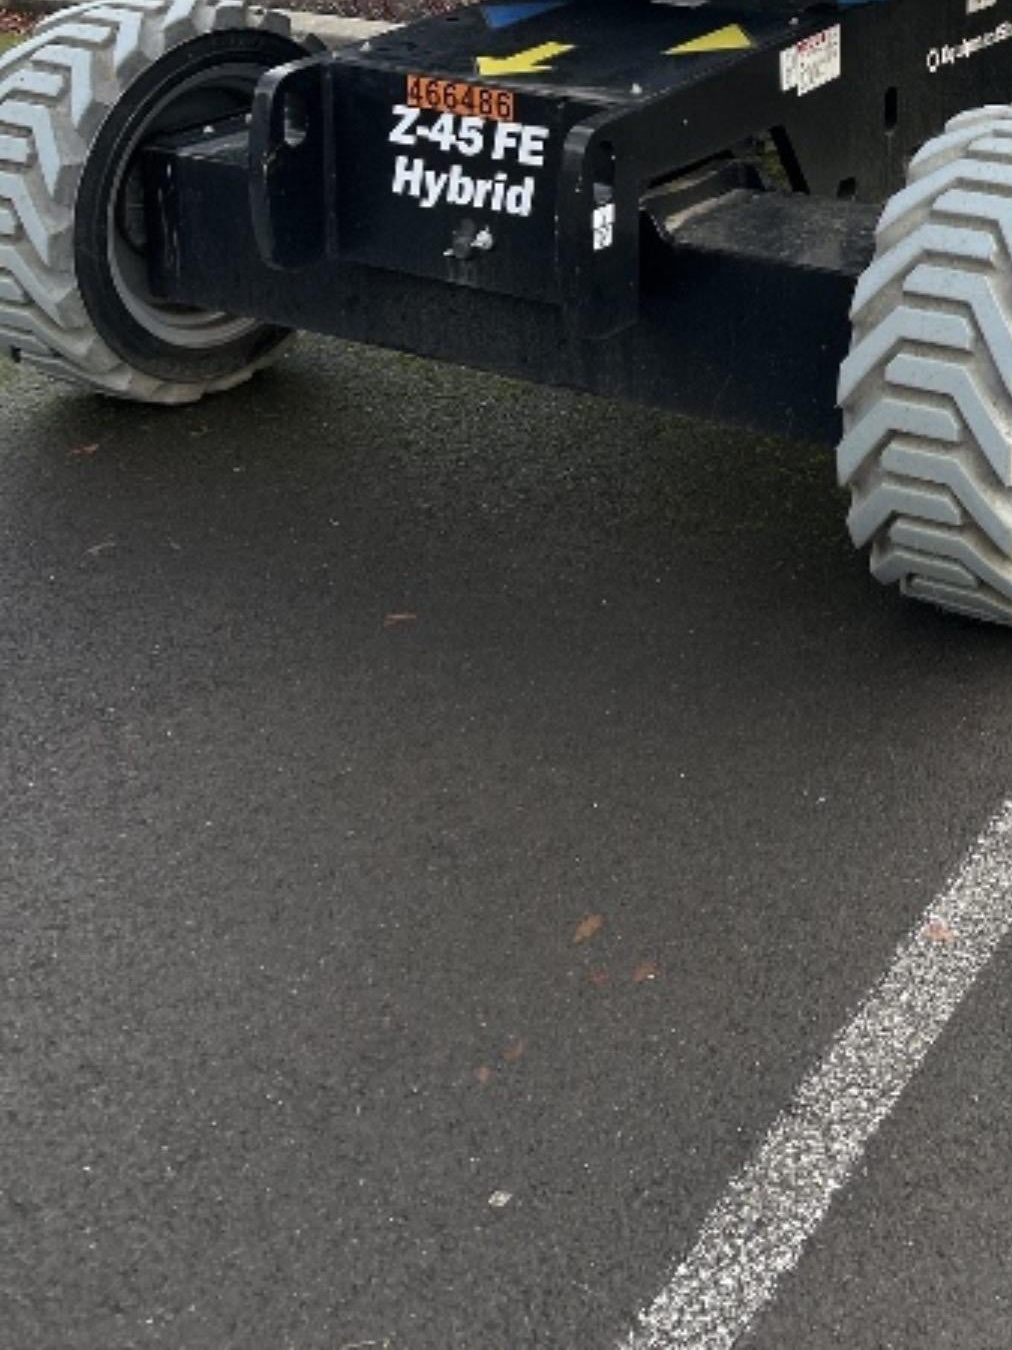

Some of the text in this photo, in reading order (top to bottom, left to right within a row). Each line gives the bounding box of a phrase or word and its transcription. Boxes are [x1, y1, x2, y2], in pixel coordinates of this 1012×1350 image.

[408, 76, 511, 119] 466486
[388, 103, 550, 167] Z-45 FE
[391, 154, 536, 217] Hybrid
